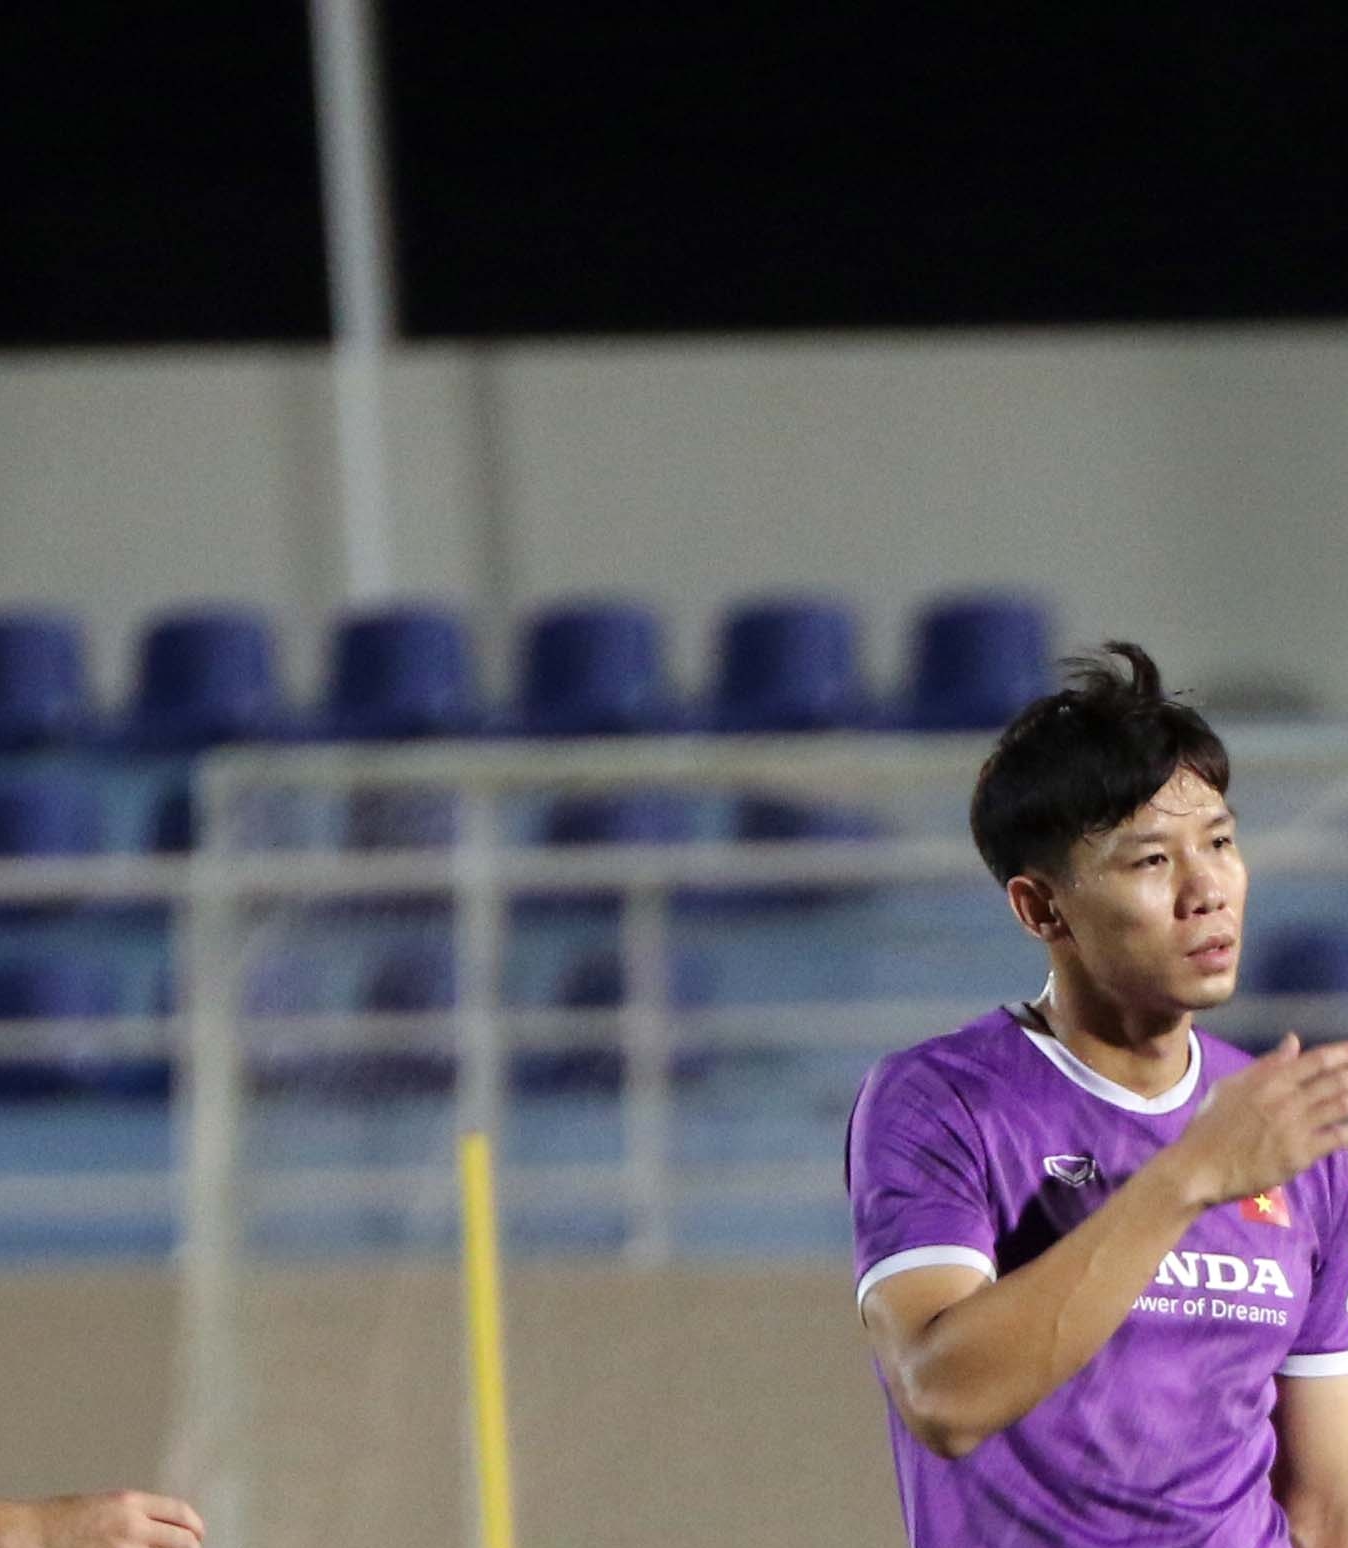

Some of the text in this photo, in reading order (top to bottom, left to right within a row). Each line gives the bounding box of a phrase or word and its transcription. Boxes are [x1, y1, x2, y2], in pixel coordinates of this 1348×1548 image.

[1154, 1250, 1294, 1298] NDA
[1182, 1297, 1206, 1317] of
[1211, 1299, 1289, 1327] Dreams
